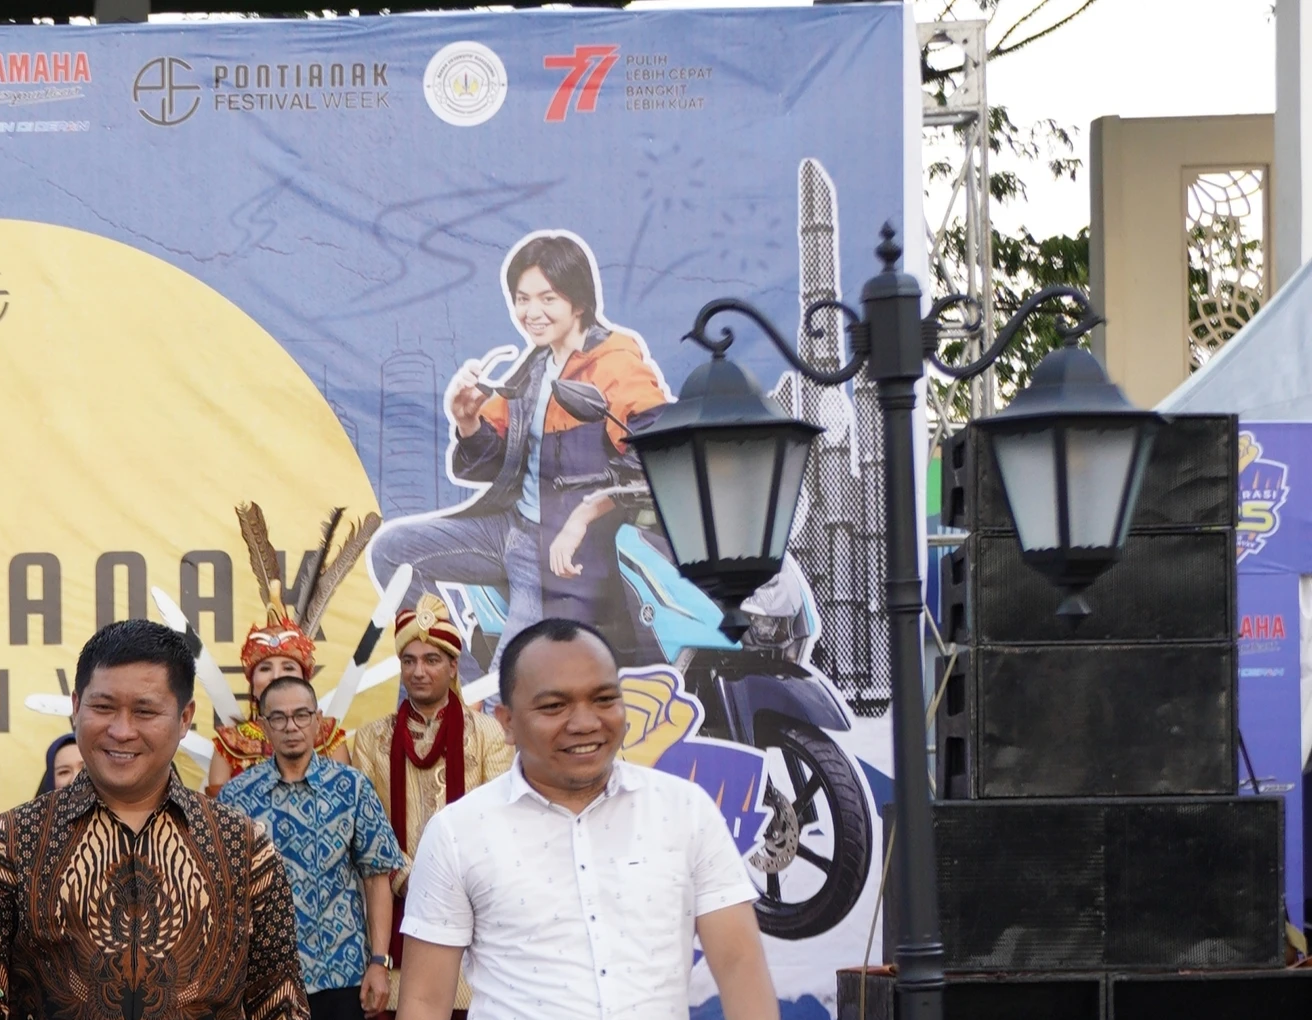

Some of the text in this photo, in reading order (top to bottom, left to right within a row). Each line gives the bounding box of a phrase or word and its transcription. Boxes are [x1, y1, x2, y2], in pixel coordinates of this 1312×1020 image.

[626, 55, 668, 66] PULIH
[214, 63, 388, 89] PONTIANAK
[626, 68, 713, 81] LEBIH CEPAT
[626, 85, 688, 97] BANGKIT
[214, 91, 390, 110] FESTIVAL WEEK
[626, 98, 705, 111] LEBIH KUAT
[1240, 615, 1286, 640] AHA
